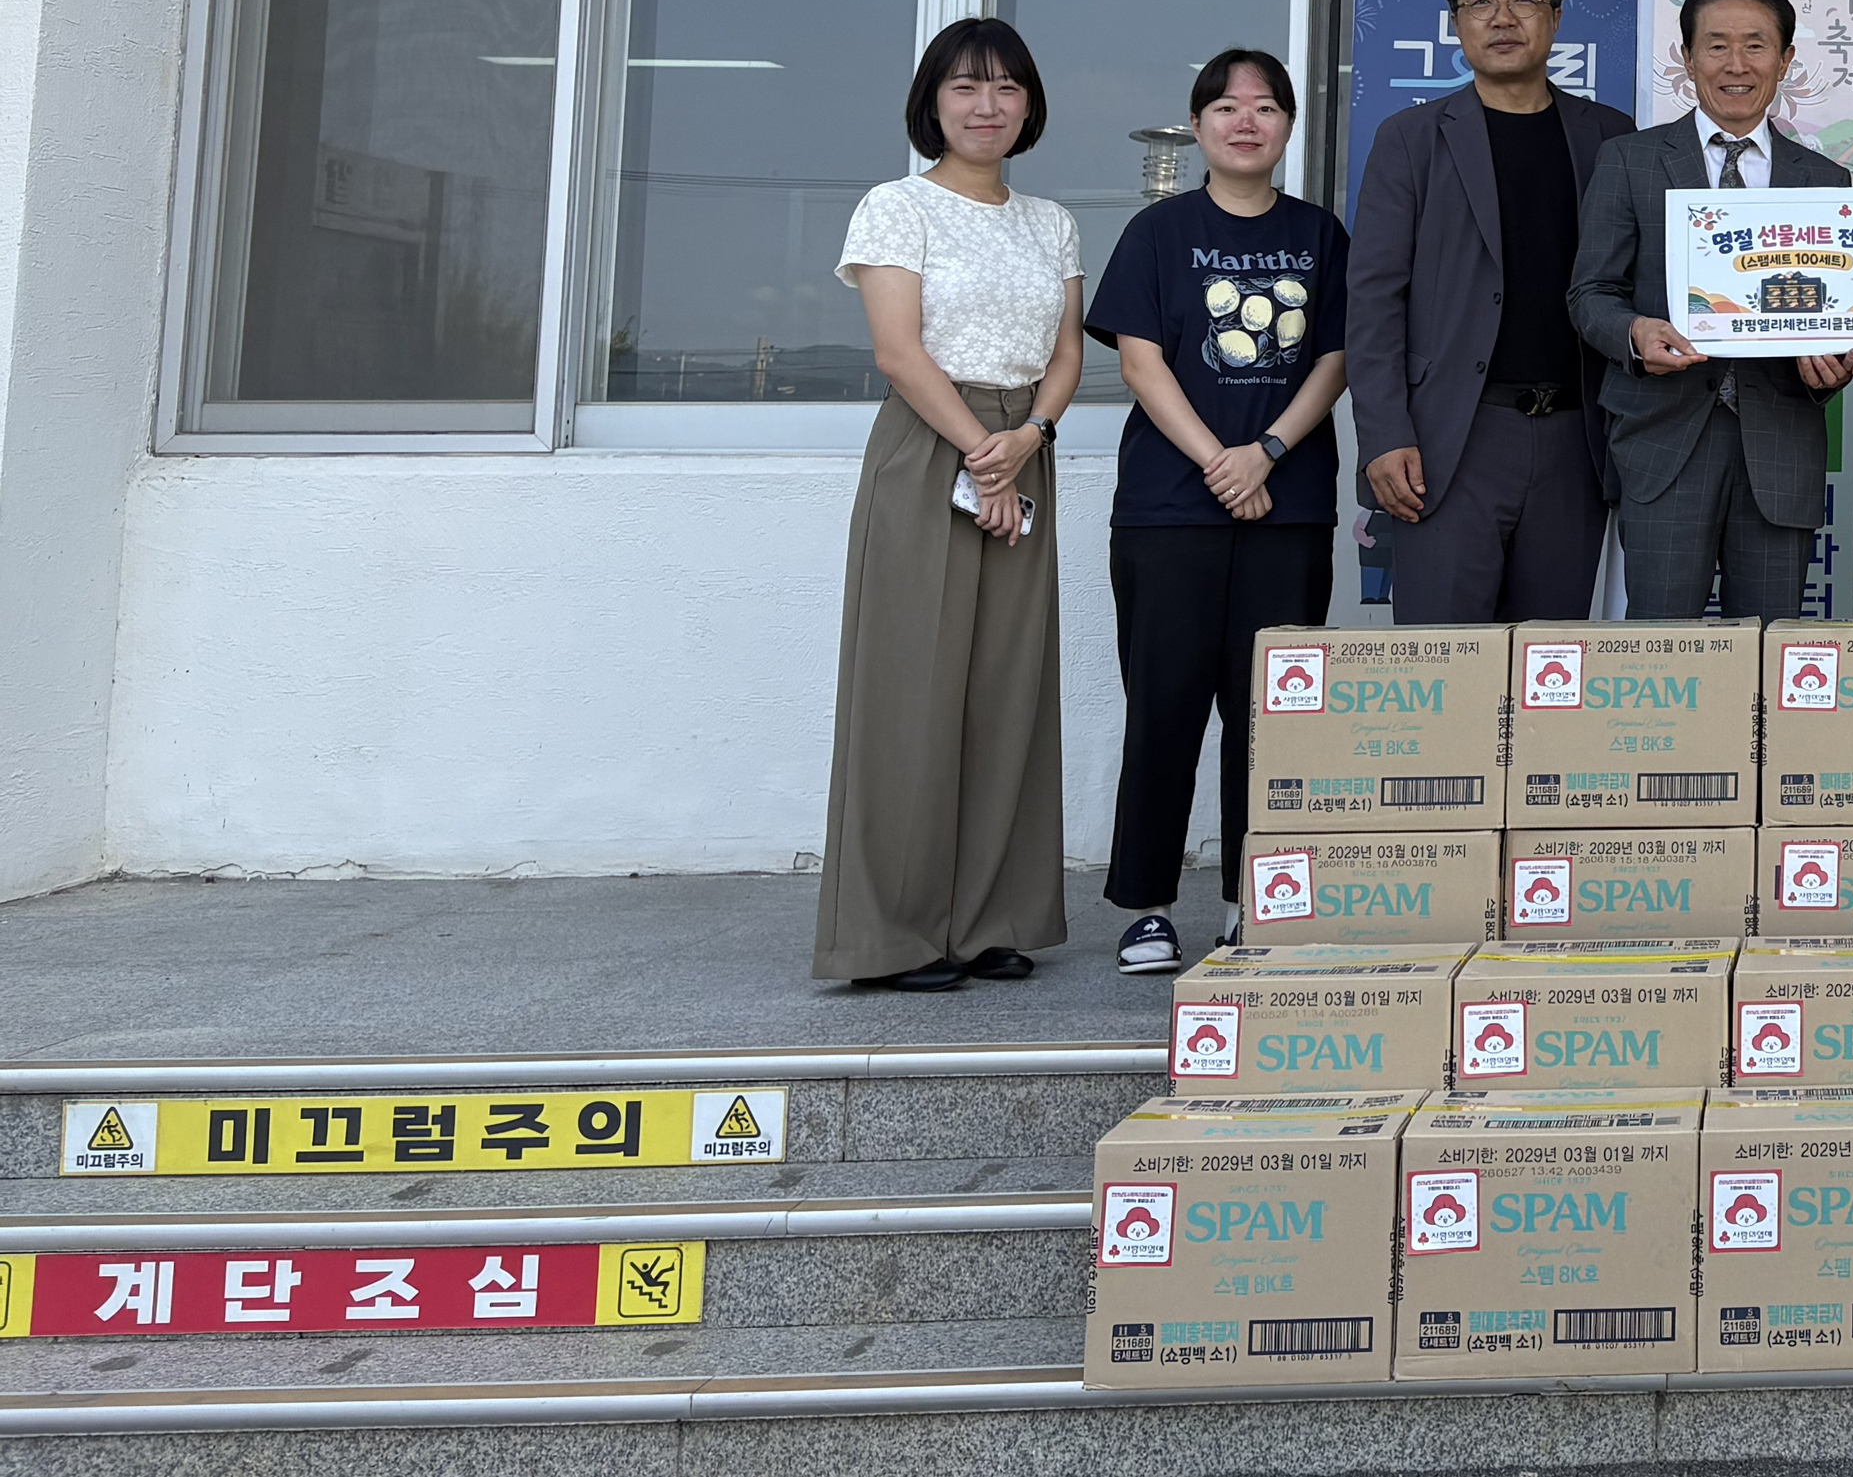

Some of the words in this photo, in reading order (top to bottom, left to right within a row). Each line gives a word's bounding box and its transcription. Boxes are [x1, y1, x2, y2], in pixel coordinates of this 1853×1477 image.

[1712, 228, 1754, 254] 명절
[1758, 225, 1833, 248] 선물세트
[1192, 248, 1315, 270] Marithé
[1740, 254, 1792, 269] (스팸세트
[1795, 253, 1846, 268] 100세트)
[1342, 642, 1385, 656] 2029년
[1391, 642, 1420, 656] 03월
[1425, 642, 1450, 655] 01일
[1456, 641, 1480, 655] 까지
[1598, 640, 1640, 653] 2029년
[1646, 640, 1675, 653] 03월
[1679, 639, 1705, 653] 01일
[1710, 639, 1733, 653] 까지
[1328, 679, 1446, 714] SPAM
[1584, 677, 1699, 710] SPAM
[1316, 883, 1432, 918] SPAM
[1578, 879, 1692, 913] SPAM
[1270, 991, 1318, 1007] 2029년
[1324, 990, 1355, 1006] 03월
[1362, 990, 1390, 1006] 01일
[1396, 990, 1423, 1005] 까지
[1548, 989, 1595, 1005] 2029년
[1602, 988, 1632, 1004] 03월
[1638, 988, 1667, 1003] 01일
[1672, 987, 1698, 1002] 까지
[1765, 983, 1820, 999] 소비기한:
[1256, 1033, 1384, 1072] SPAM
[1534, 1030, 1661, 1067] SPAM
[207, 1098, 644, 1167] 미끄럼주의
[703, 1138, 772, 1158] 미끄럼주의
[1438, 1147, 1498, 1165] 소비기한:
[1505, 1146, 1557, 1164] 2029년
[1563, 1146, 1597, 1163] 03월
[1603, 1145, 1635, 1162] 01일
[1640, 1145, 1669, 1161] 까지
[1735, 1142, 1793, 1160] 소비기한:
[1801, 1141, 1851, 1158] 2029년
[76, 1149, 145, 1170] 미끄럼주의
[1133, 1155, 1194, 1173] 소비기한:
[1201, 1154, 1253, 1172] 2029년
[1260, 1153, 1295, 1171] 03월
[1300, 1153, 1332, 1170] 01일
[1338, 1152, 1367, 1169] 까지
[1480, 1167, 1525, 1178] 260527
[1531, 1166, 1563, 1176] 13:42
[1185, 1201, 1325, 1243] SPAM
[1490, 1192, 1628, 1234] SPAM
[94, 1253, 540, 1325] 계단조심
[1422, 1325, 1458, 1336] 211689
[1723, 1320, 1758, 1332] 211689
[1115, 1337, 1151, 1349] 211689
[1466, 1334, 1512, 1353] (쇼핑백
[1516, 1334, 1543, 1352] 소1)
[1767, 1329, 1812, 1348] (쇼핑백
[1816, 1329, 1842, 1347] 소1)
[1160, 1346, 1206, 1365] (쇼핑백
[1211, 1346, 1237, 1364] 소1)
